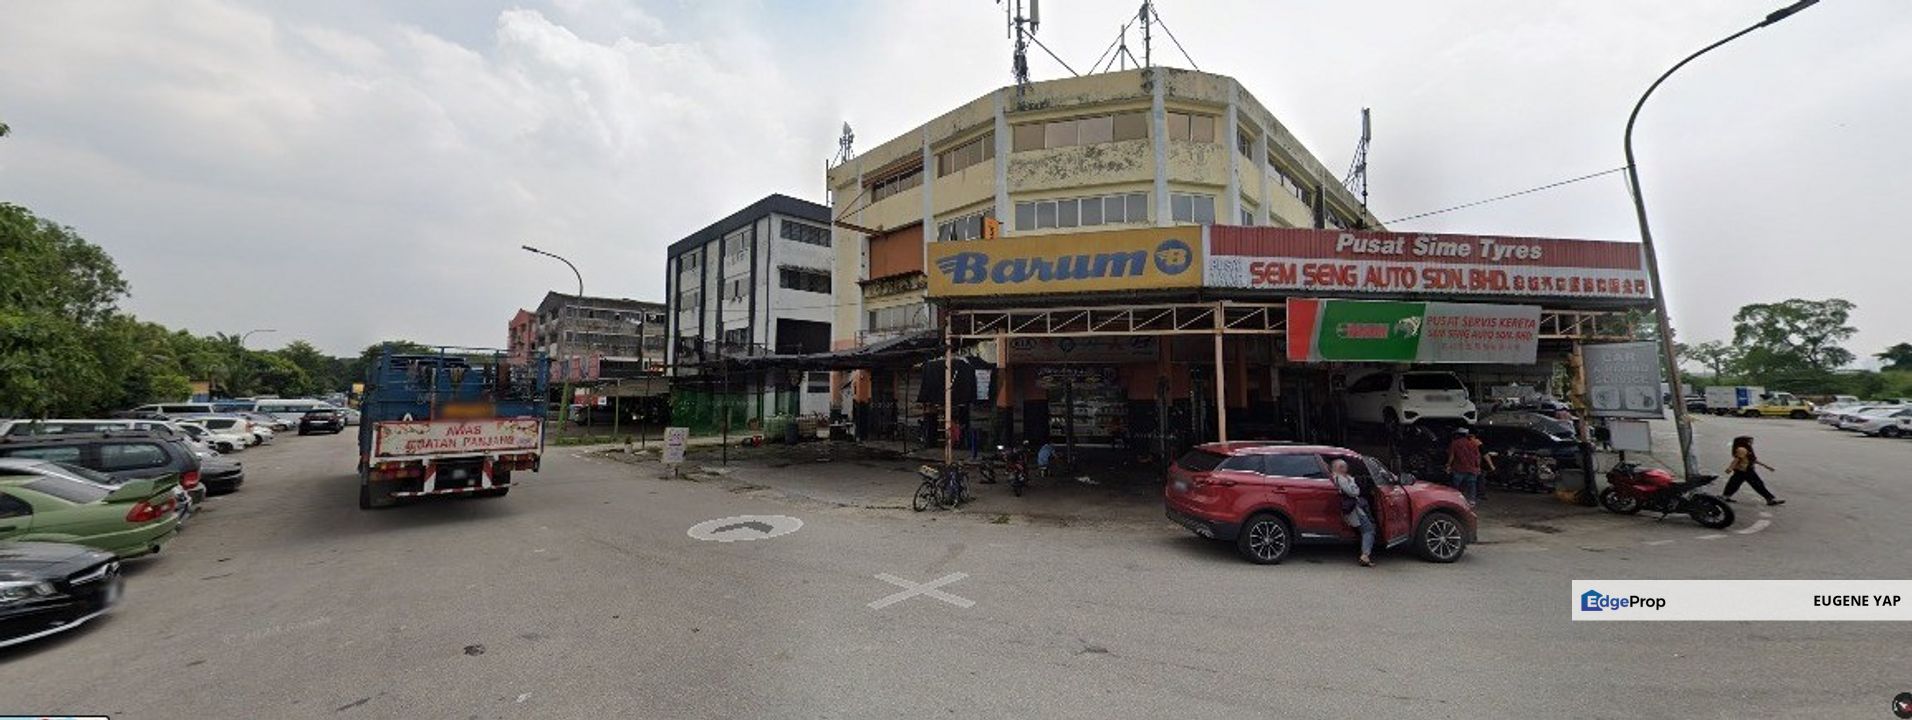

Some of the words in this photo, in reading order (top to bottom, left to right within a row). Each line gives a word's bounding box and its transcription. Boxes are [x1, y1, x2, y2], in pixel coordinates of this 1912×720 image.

[1335, 232, 1404, 255] Pusat
[1412, 235, 1470, 257] Sime
[1479, 238, 1543, 261] Tyres
[936, 248, 1148, 285] Barum
[1249, 261, 1297, 285] SEM
[1303, 263, 1358, 287] SENG
[1363, 265, 1417, 289] AUTO
[1422, 267, 1467, 290] SDN.
[1469, 269, 1510, 291] BHD.
[1426, 316, 1459, 327] PUSAT
[1462, 316, 1498, 328] SERVIS
[1498, 318, 1536, 329] KERETA
[445, 425, 482, 437] AWAS
